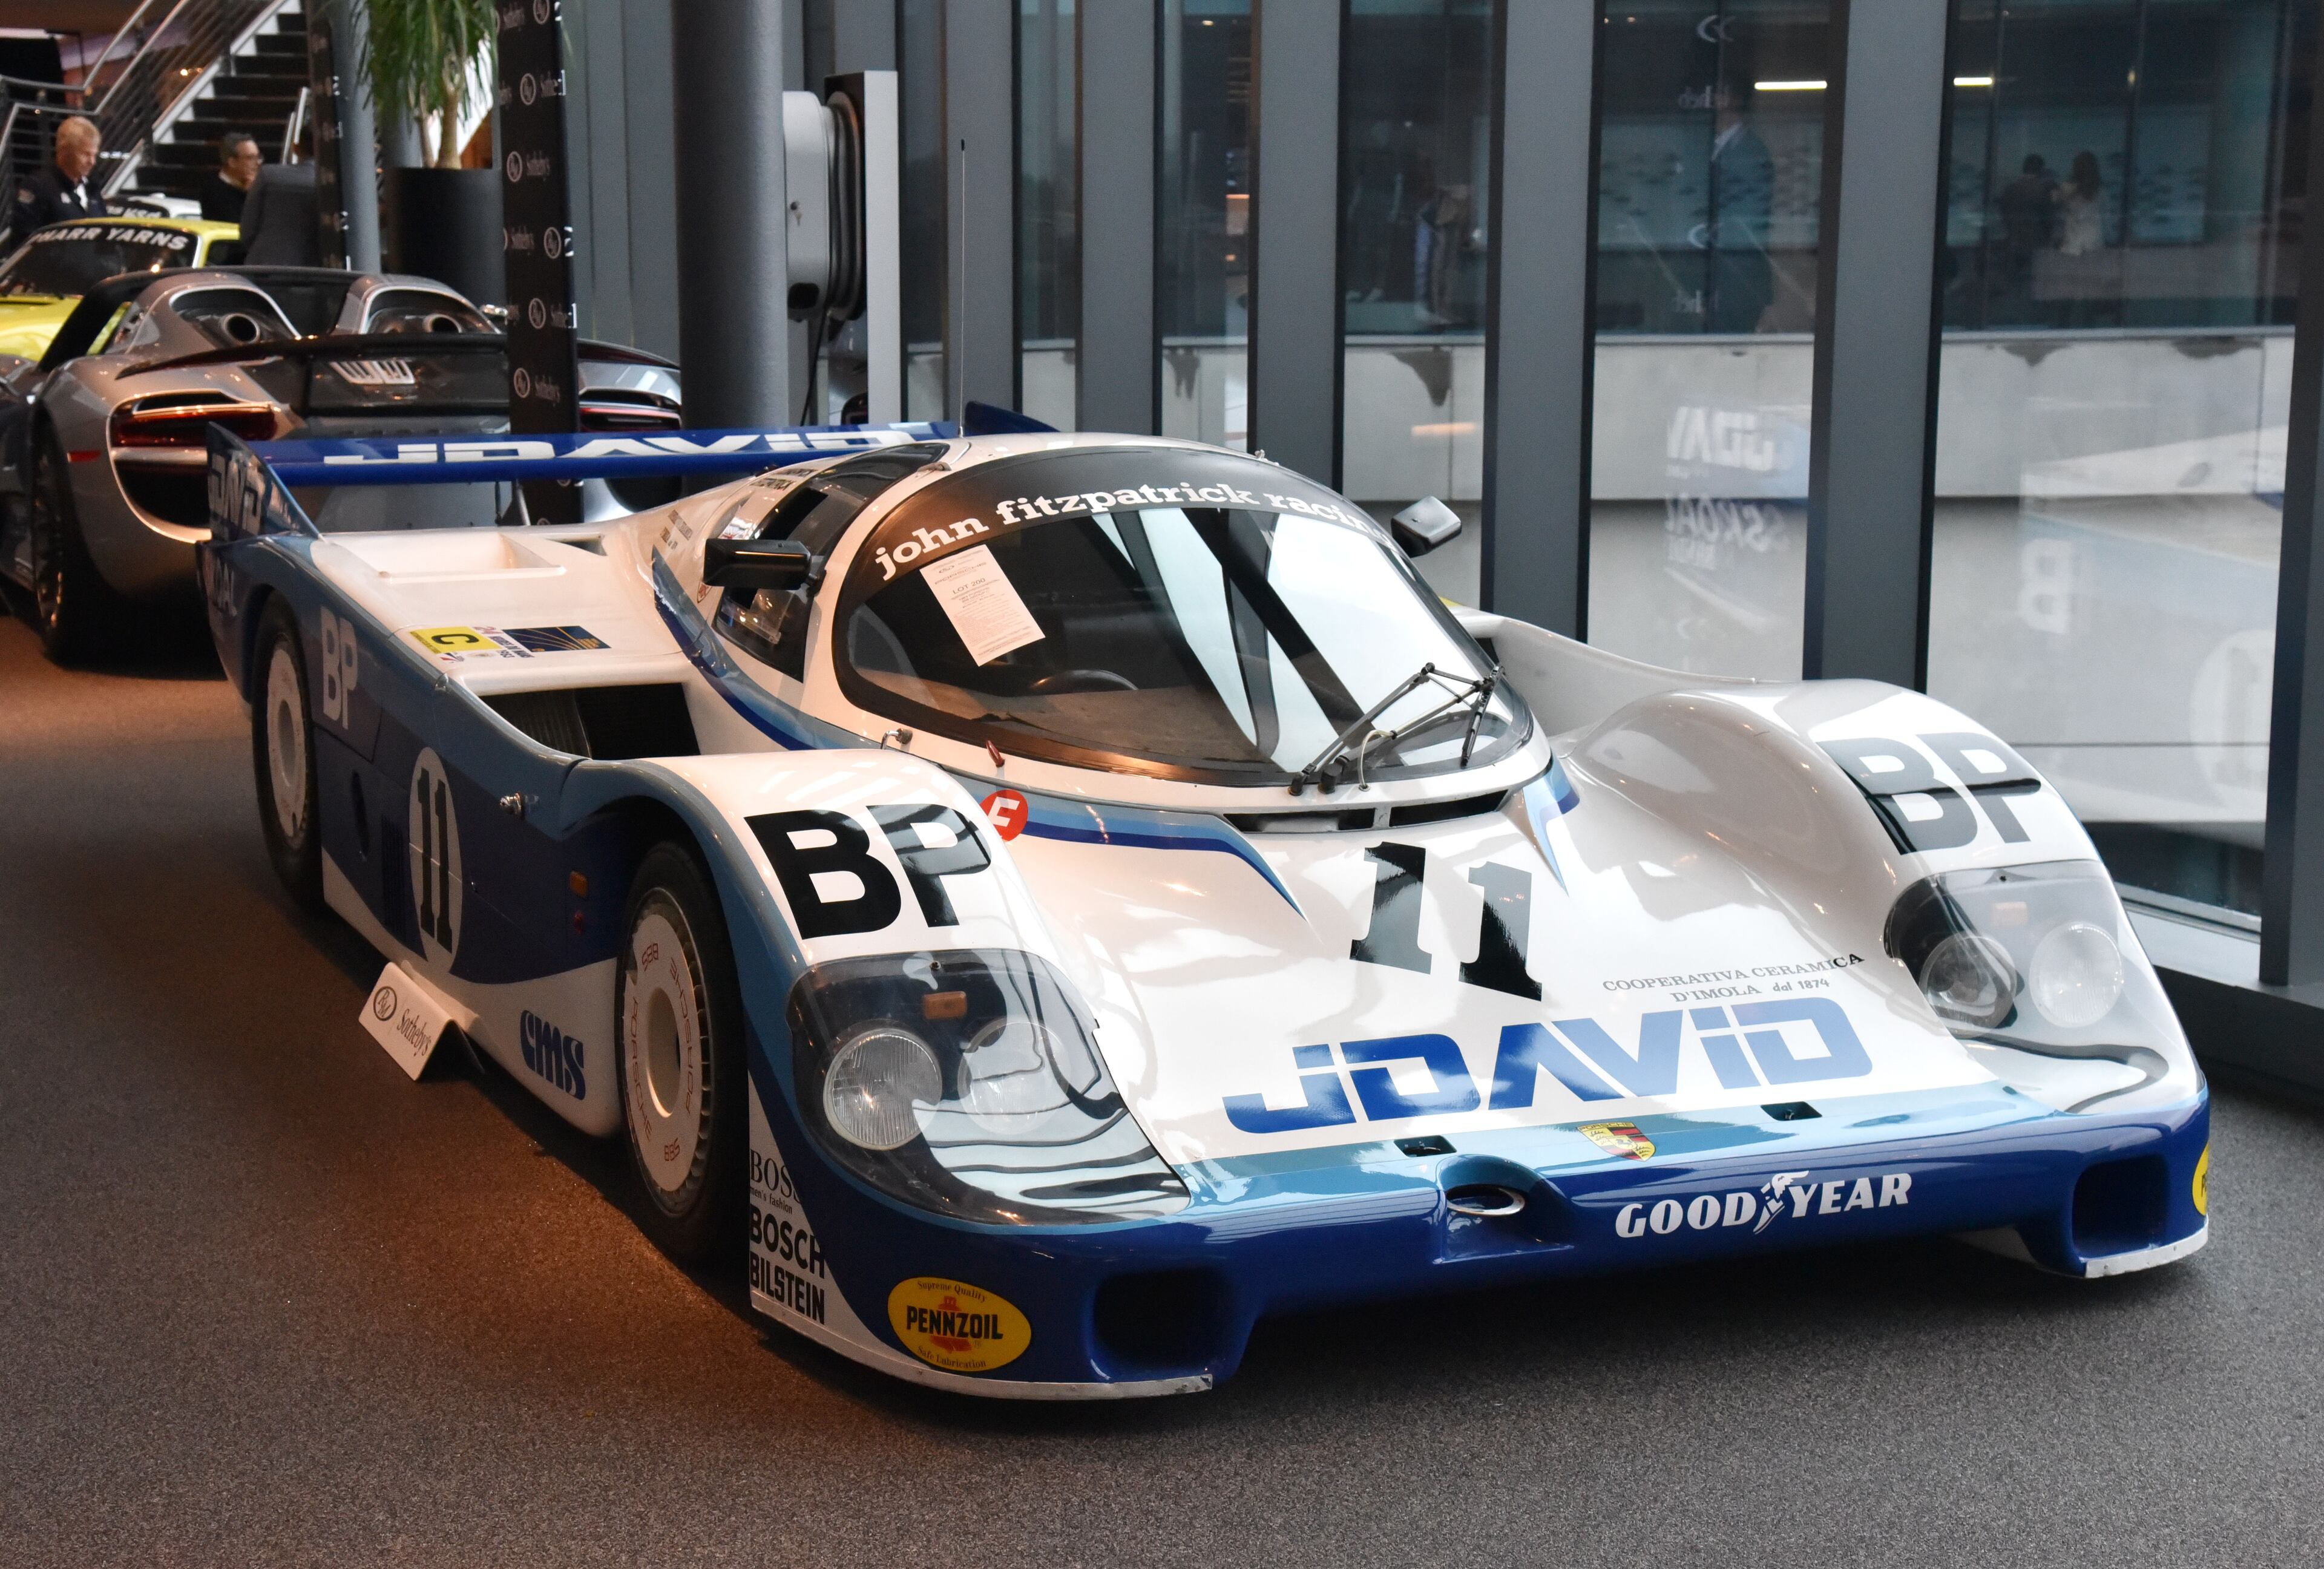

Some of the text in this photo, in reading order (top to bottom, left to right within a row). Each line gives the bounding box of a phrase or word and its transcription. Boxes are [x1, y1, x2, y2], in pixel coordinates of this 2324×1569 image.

[106, 228, 189, 249] YARNS
[875, 518, 990, 581] john
[996, 482, 1261, 525] fitzpatrick
[953, 584, 968, 594] LOT
[970, 578, 986, 586] 200
[431, 634, 479, 645] C
[320, 606, 358, 730] BP
[986, 796, 1020, 828] E
[1816, 731, 2042, 856] BP
[417, 767, 453, 954] 11
[743, 803, 992, 940] BP
[1349, 840, 1543, 1002] 11
[1602, 952, 1865, 992] COOPERATIVA CERAMICA
[1669, 977, 1831, 1003] D'IMOLA dal 1874
[396, 1008, 432, 1057] Sotheby's
[769, 1191, 793, 1214] fashion
[749, 1202, 825, 1280] BOSCH
[749, 1250, 825, 1325] BILSTEIN
[917, 1280, 986, 1303] Supreme Quality
[907, 1305, 1004, 1340] PENNZOIL
[917, 1345, 987, 1368] Safe Lubrication
